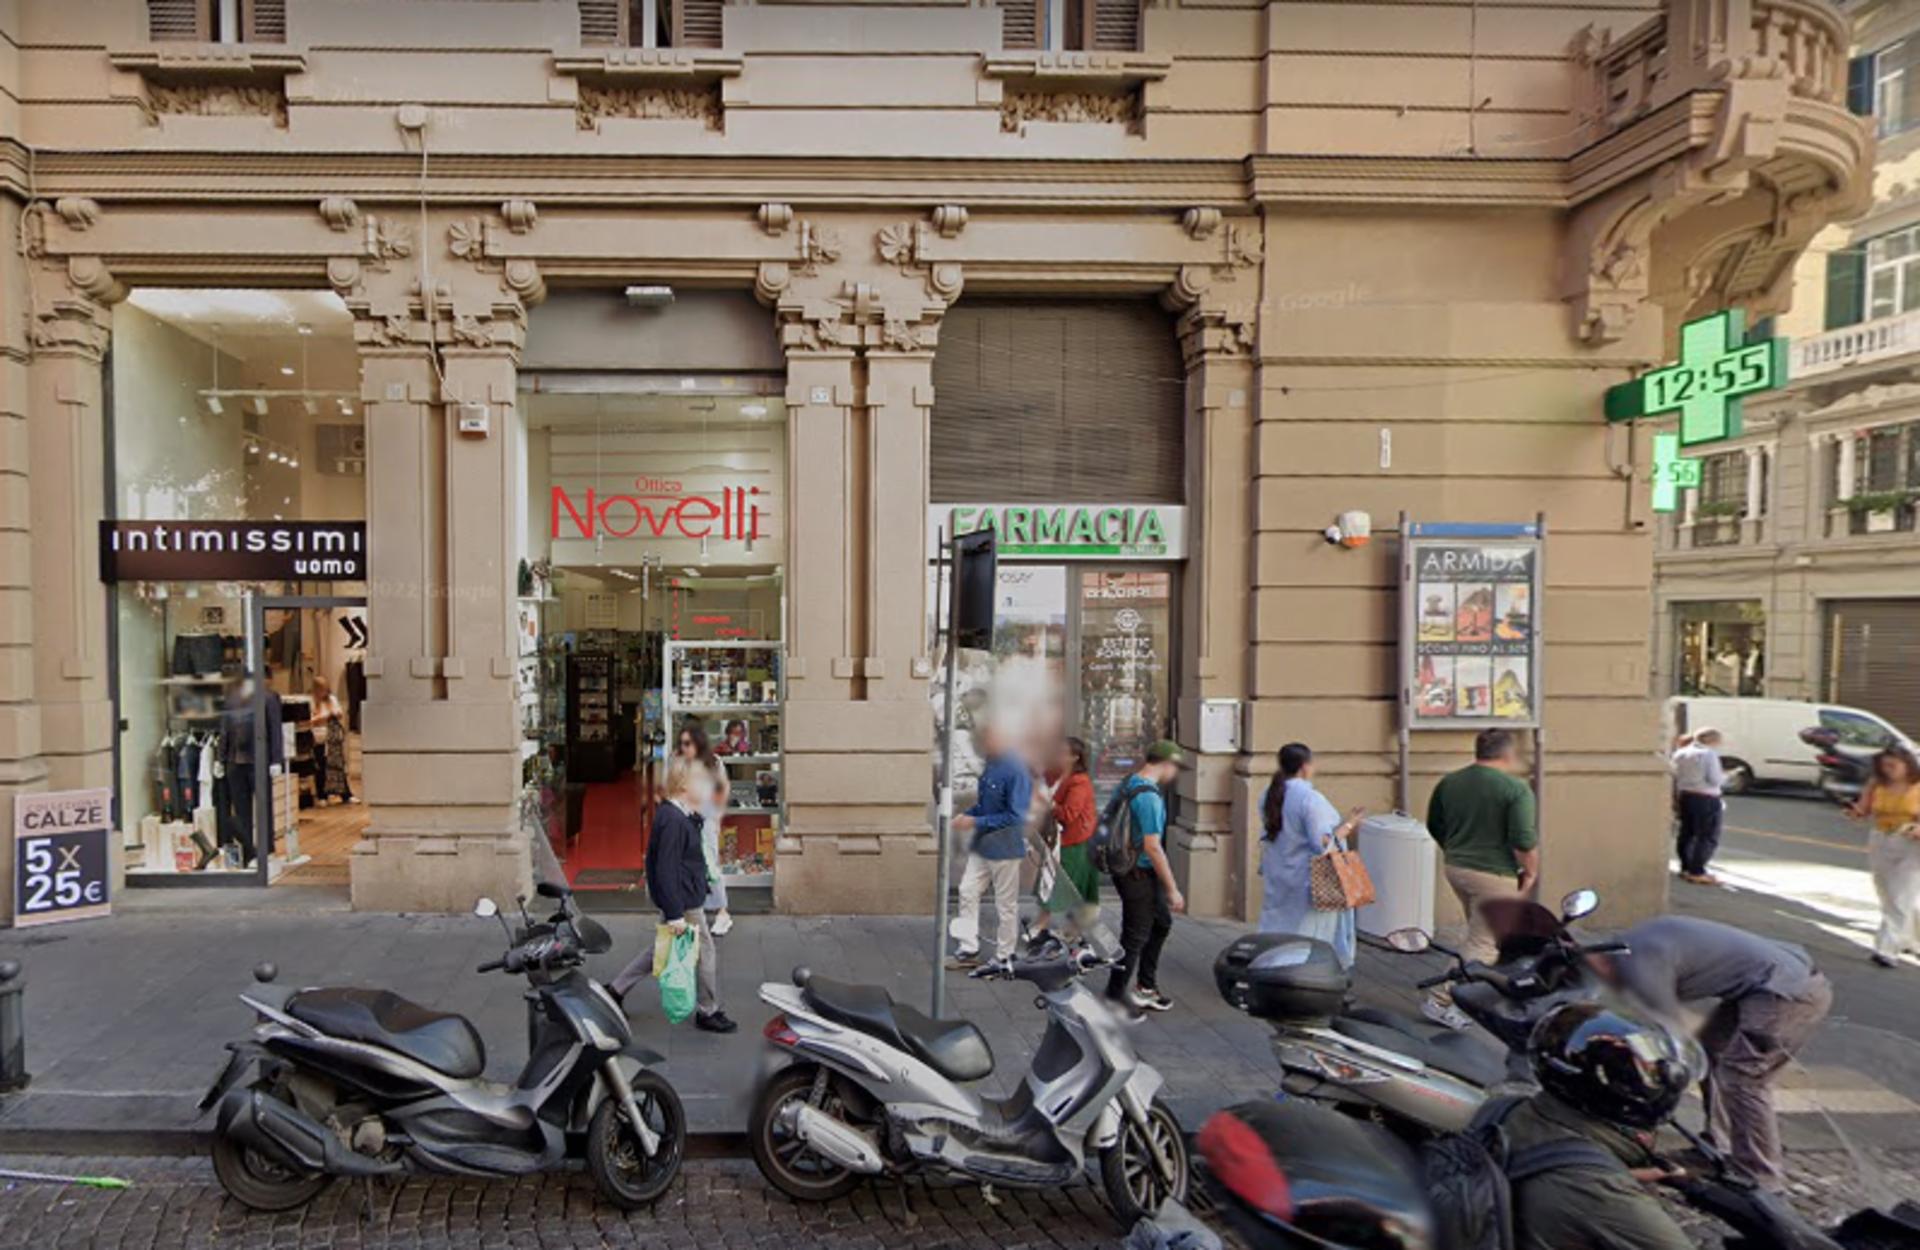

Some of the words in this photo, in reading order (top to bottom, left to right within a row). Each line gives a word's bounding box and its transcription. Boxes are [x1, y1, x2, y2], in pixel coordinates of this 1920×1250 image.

[1653, 348, 1765, 406] 12:55
[635, 475, 683, 492] Ottica
[551, 486, 760, 541] Novelli
[952, 507, 1167, 544] FARMACIA
[112, 525, 362, 552] intimissimi
[294, 558, 356, 575] uomo
[1423, 551, 1527, 571] ARMIDA
[23, 806, 104, 830] CALZE
[25, 837, 52, 874] 5
[25, 871, 103, 911] 25€
